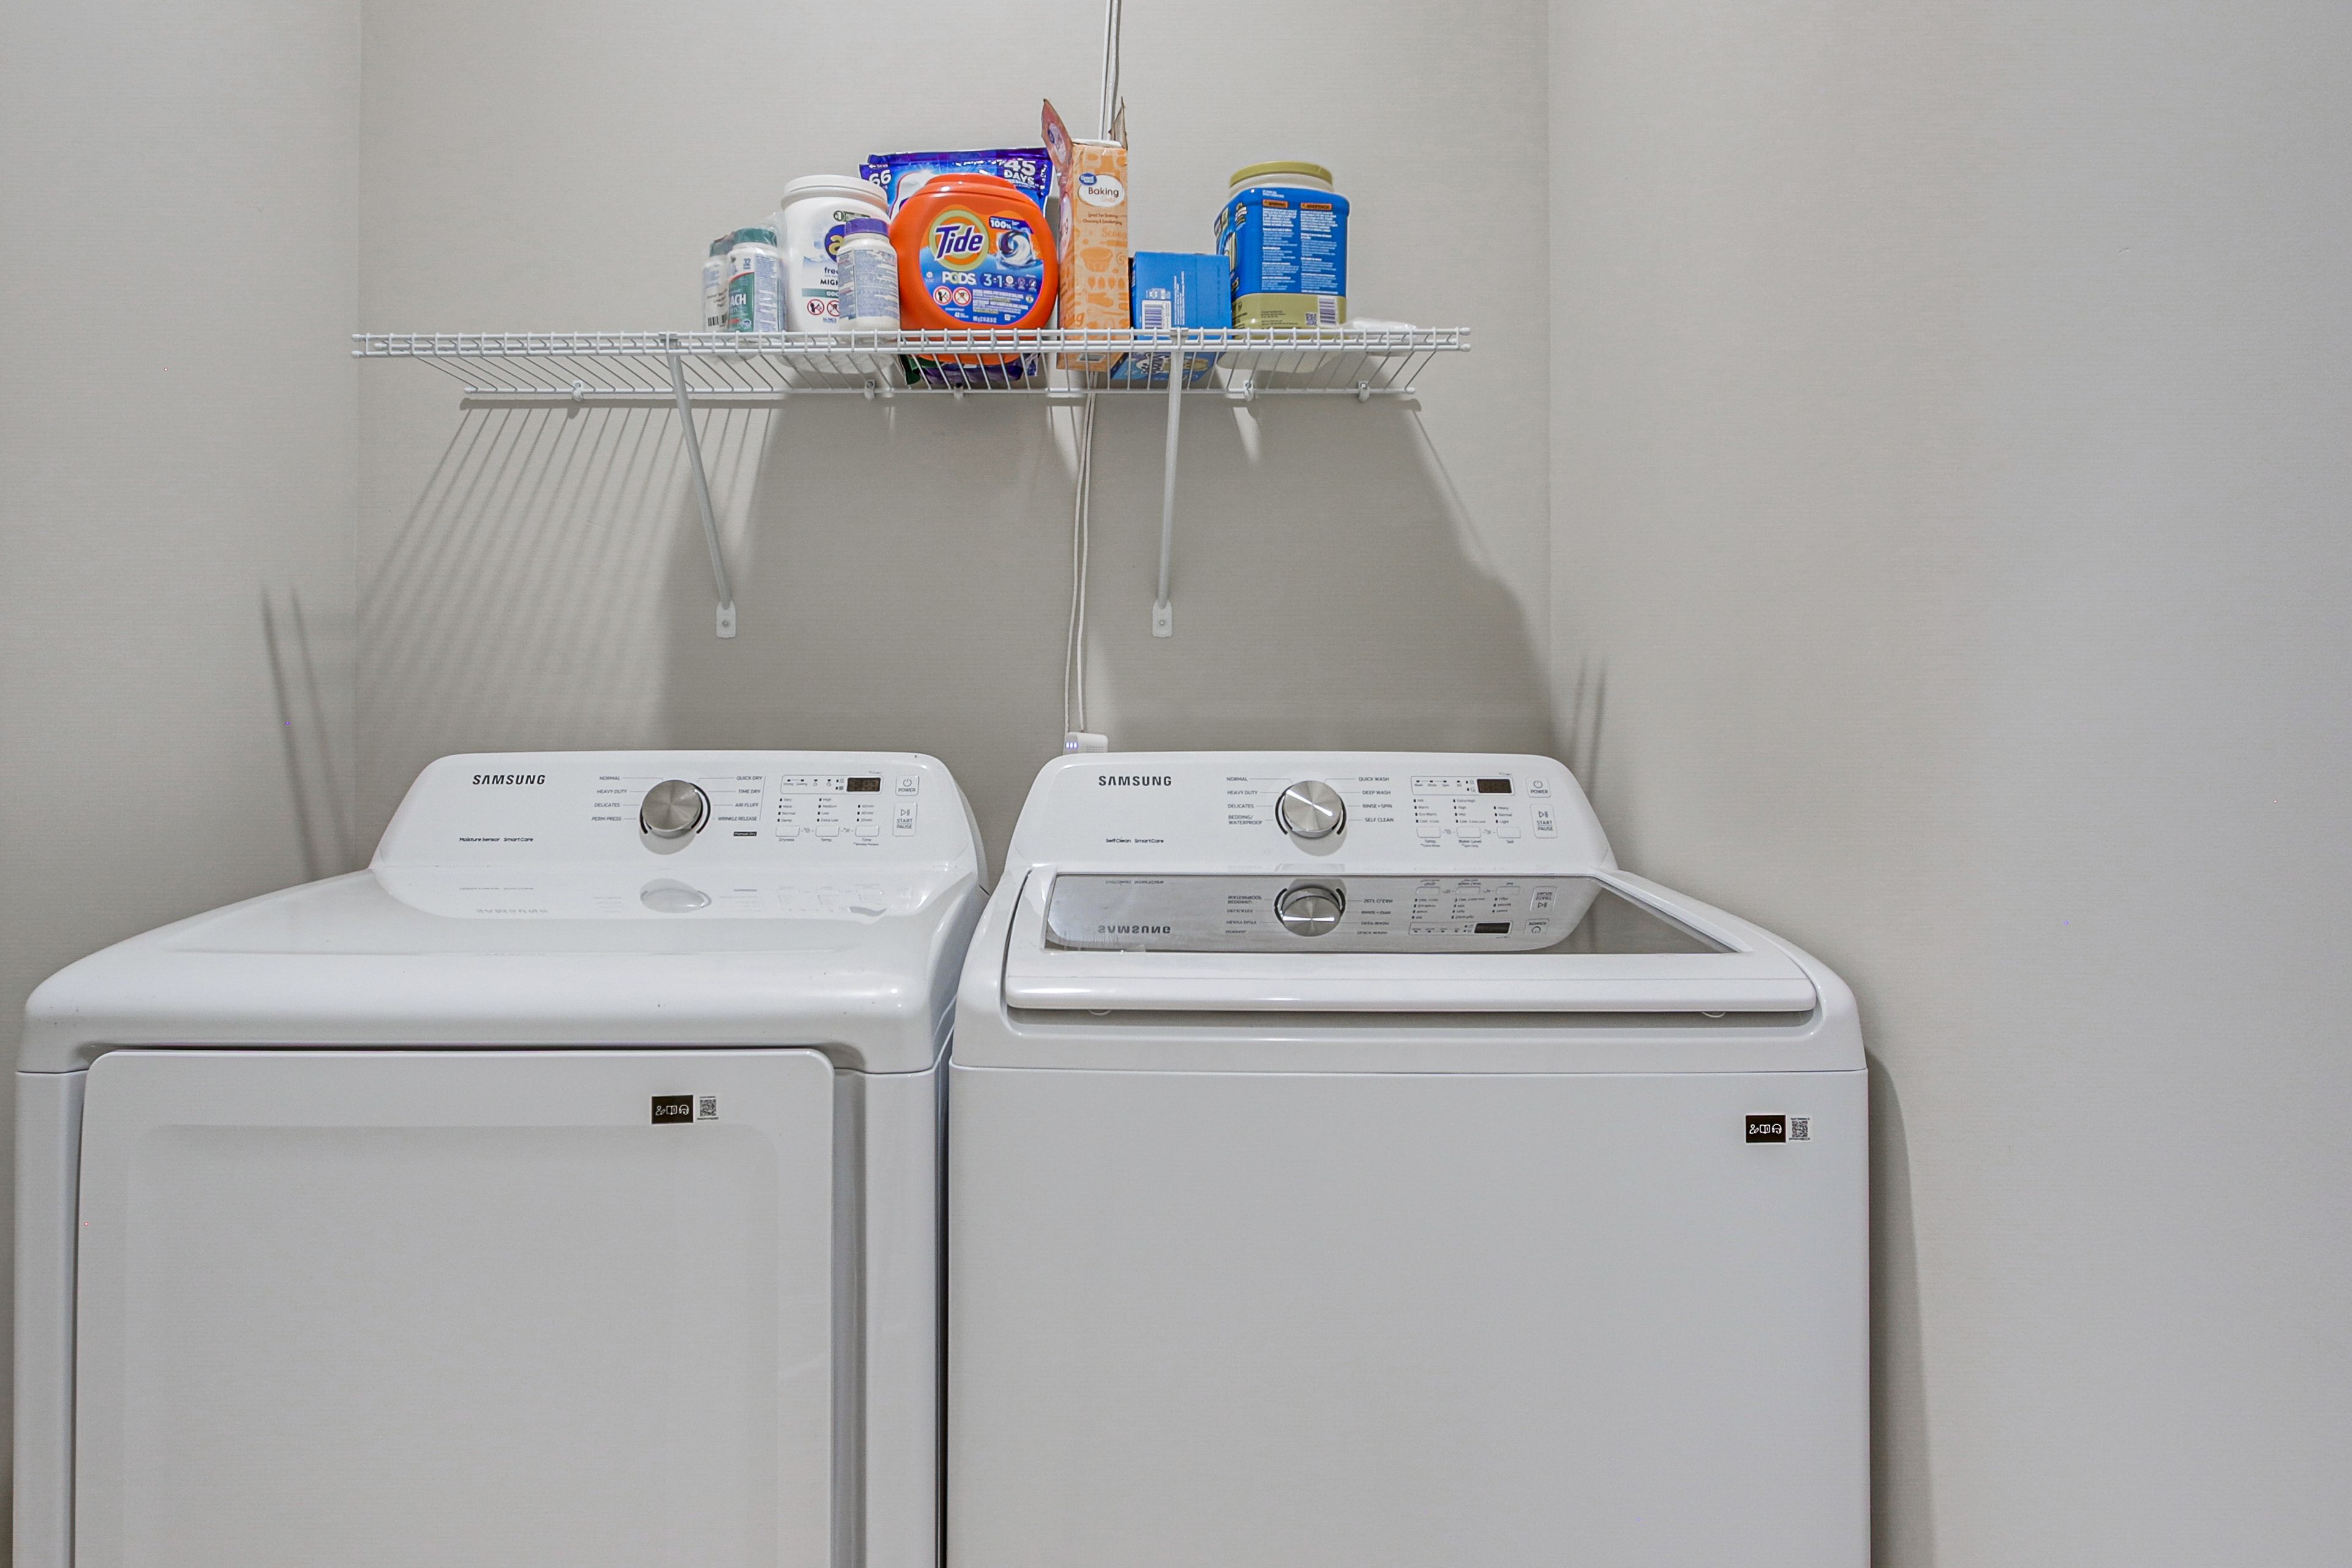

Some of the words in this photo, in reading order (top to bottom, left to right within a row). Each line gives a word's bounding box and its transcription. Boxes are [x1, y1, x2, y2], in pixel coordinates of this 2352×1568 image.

[1004, 160, 1036, 176] 45
[869, 170, 892, 187] 66
[1004, 170, 1035, 186] DAYS
[1088, 187, 1120, 198] Baking
[989, 219, 1012, 230] 100%
[934, 224, 984, 260] Tide
[942, 271, 976, 285] PODS
[472, 775, 546, 785] SAMSUNG
[1098, 775, 1172, 786] SAMSUNG
